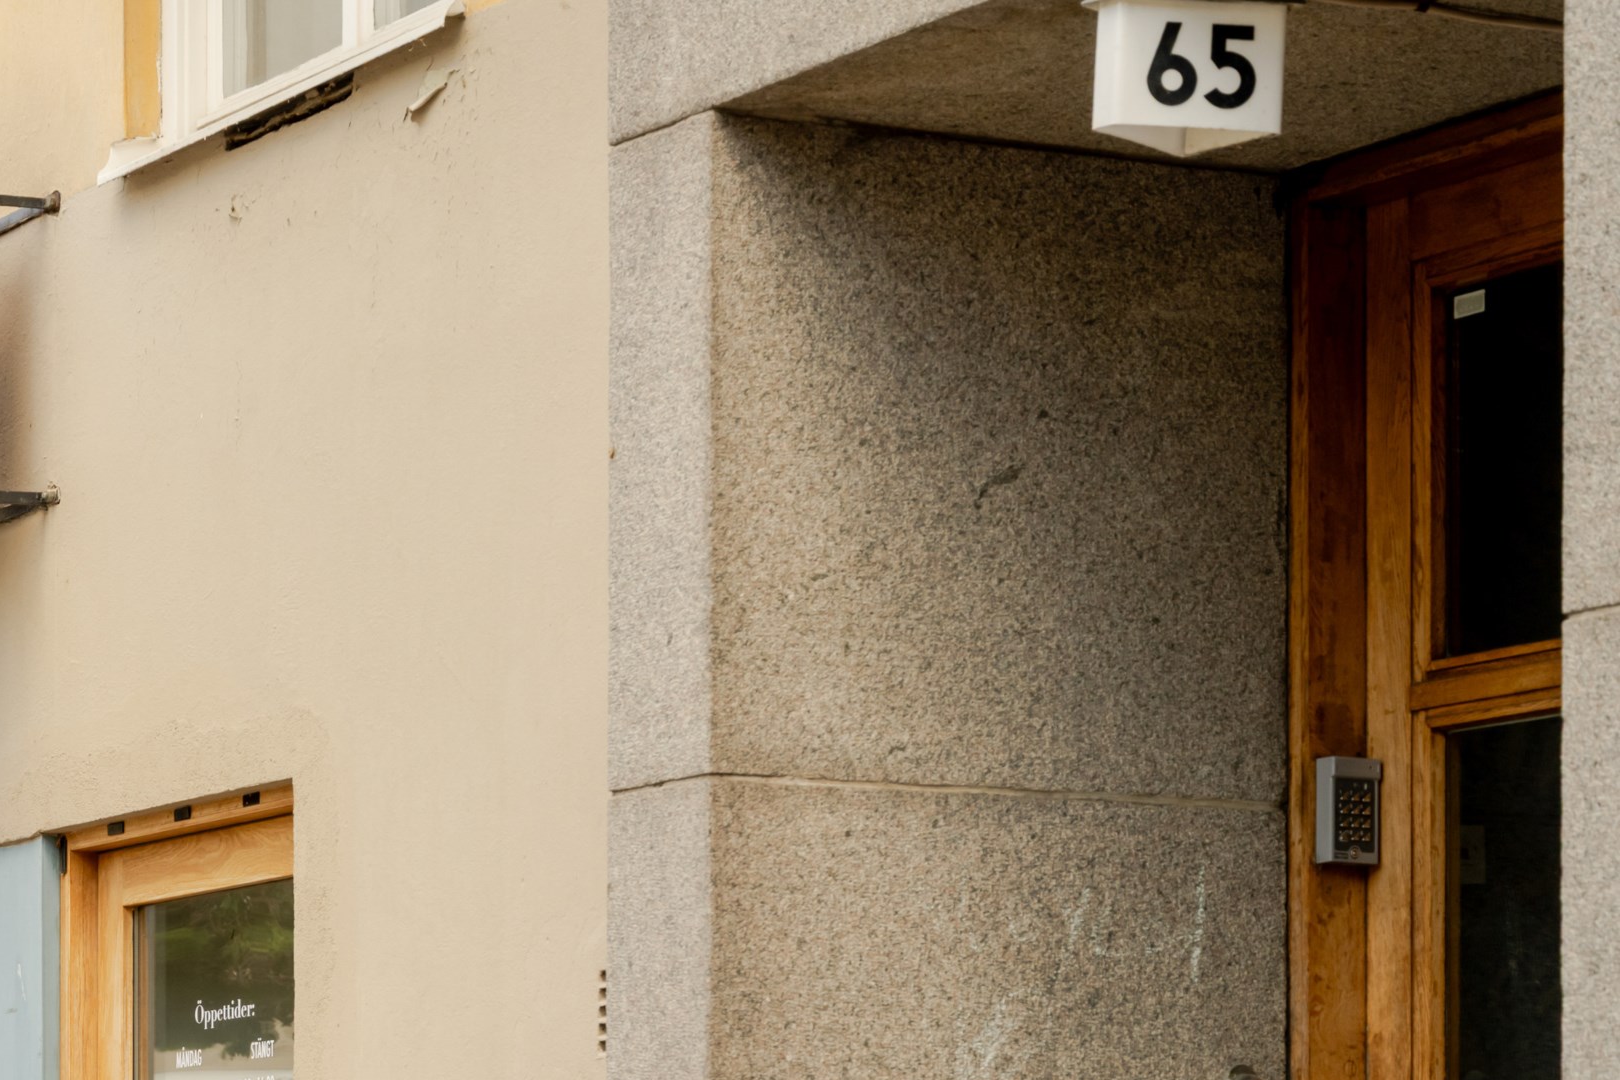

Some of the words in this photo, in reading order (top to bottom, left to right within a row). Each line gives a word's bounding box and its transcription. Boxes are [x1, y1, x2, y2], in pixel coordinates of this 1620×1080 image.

[1146, 21, 1256, 109] 65
[194, 999, 256, 1030] Öppettider:
[175, 1047, 202, 1069] MÅNDAG
[250, 1038, 275, 1059] STÄNGT
